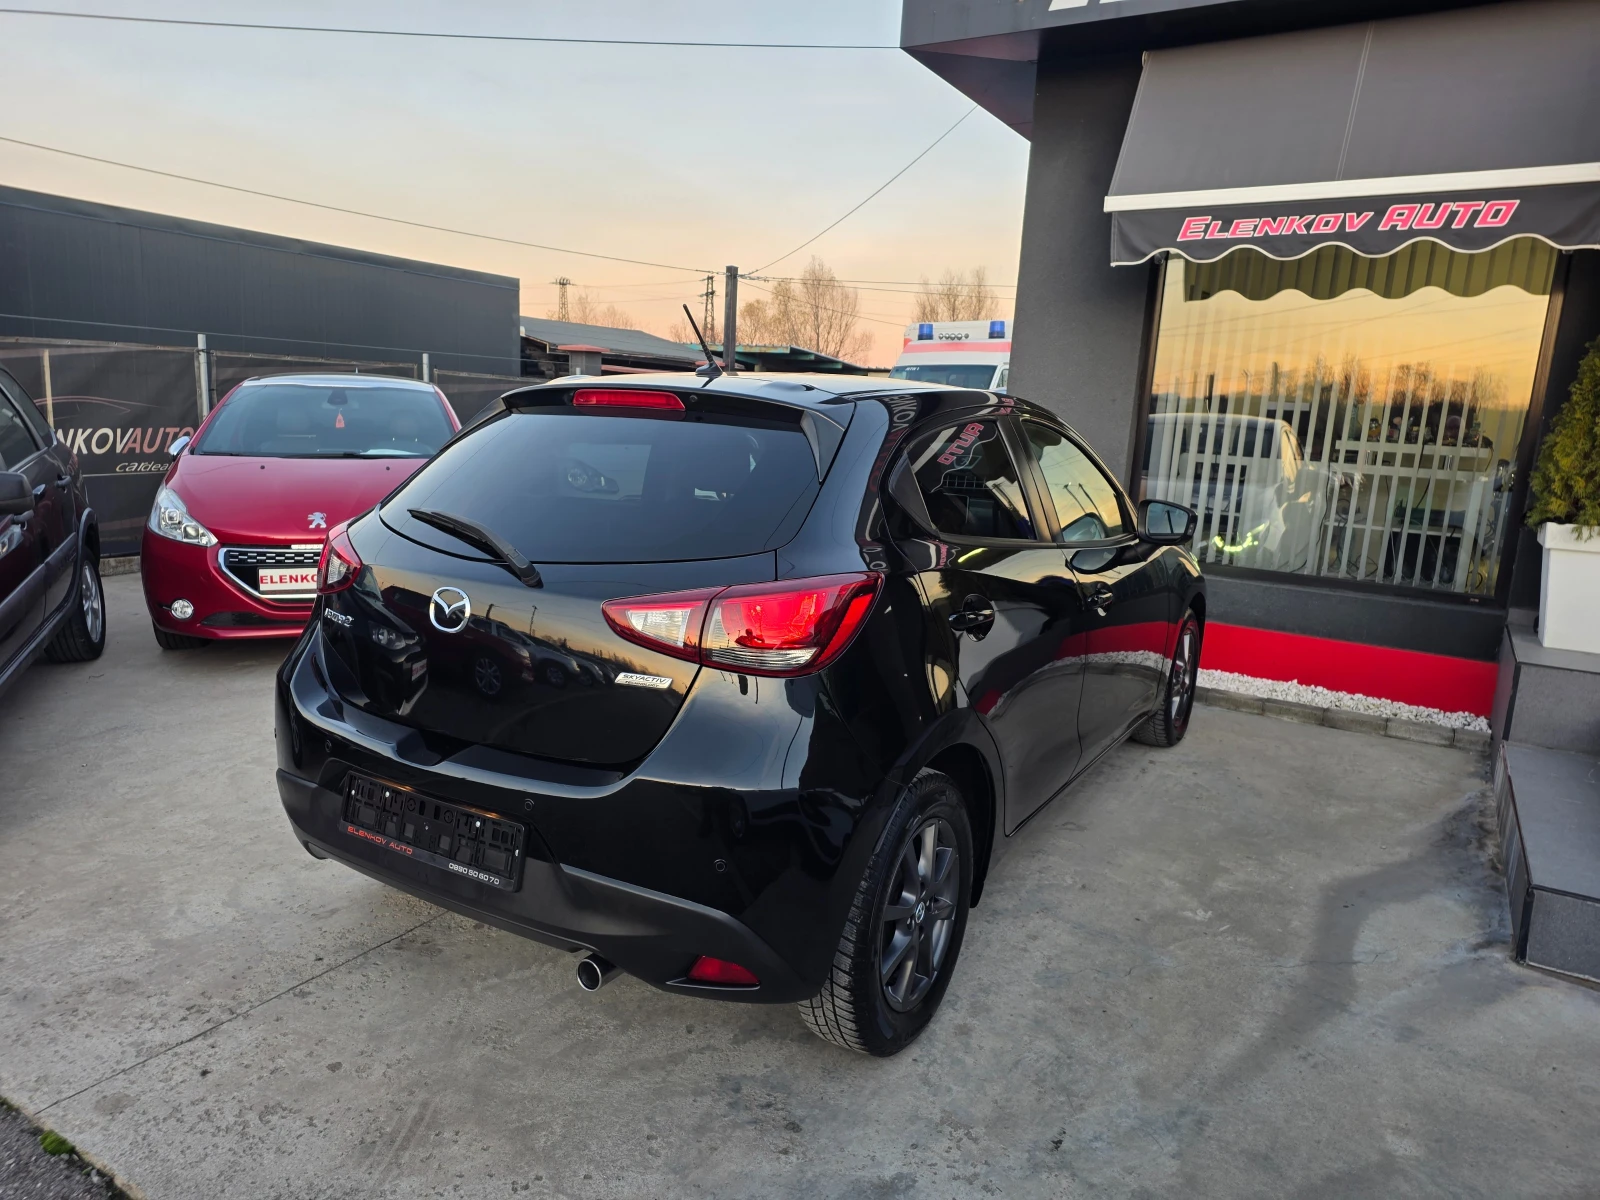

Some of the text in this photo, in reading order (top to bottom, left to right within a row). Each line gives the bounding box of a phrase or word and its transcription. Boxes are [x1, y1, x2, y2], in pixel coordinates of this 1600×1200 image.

[1176, 199, 1521, 241] ELENKOV AUTO
[621, 673, 667, 683] SKYACTIV
[347, 825, 413, 855] ELENKOV AUTO
[489, 875, 500, 885] 70
